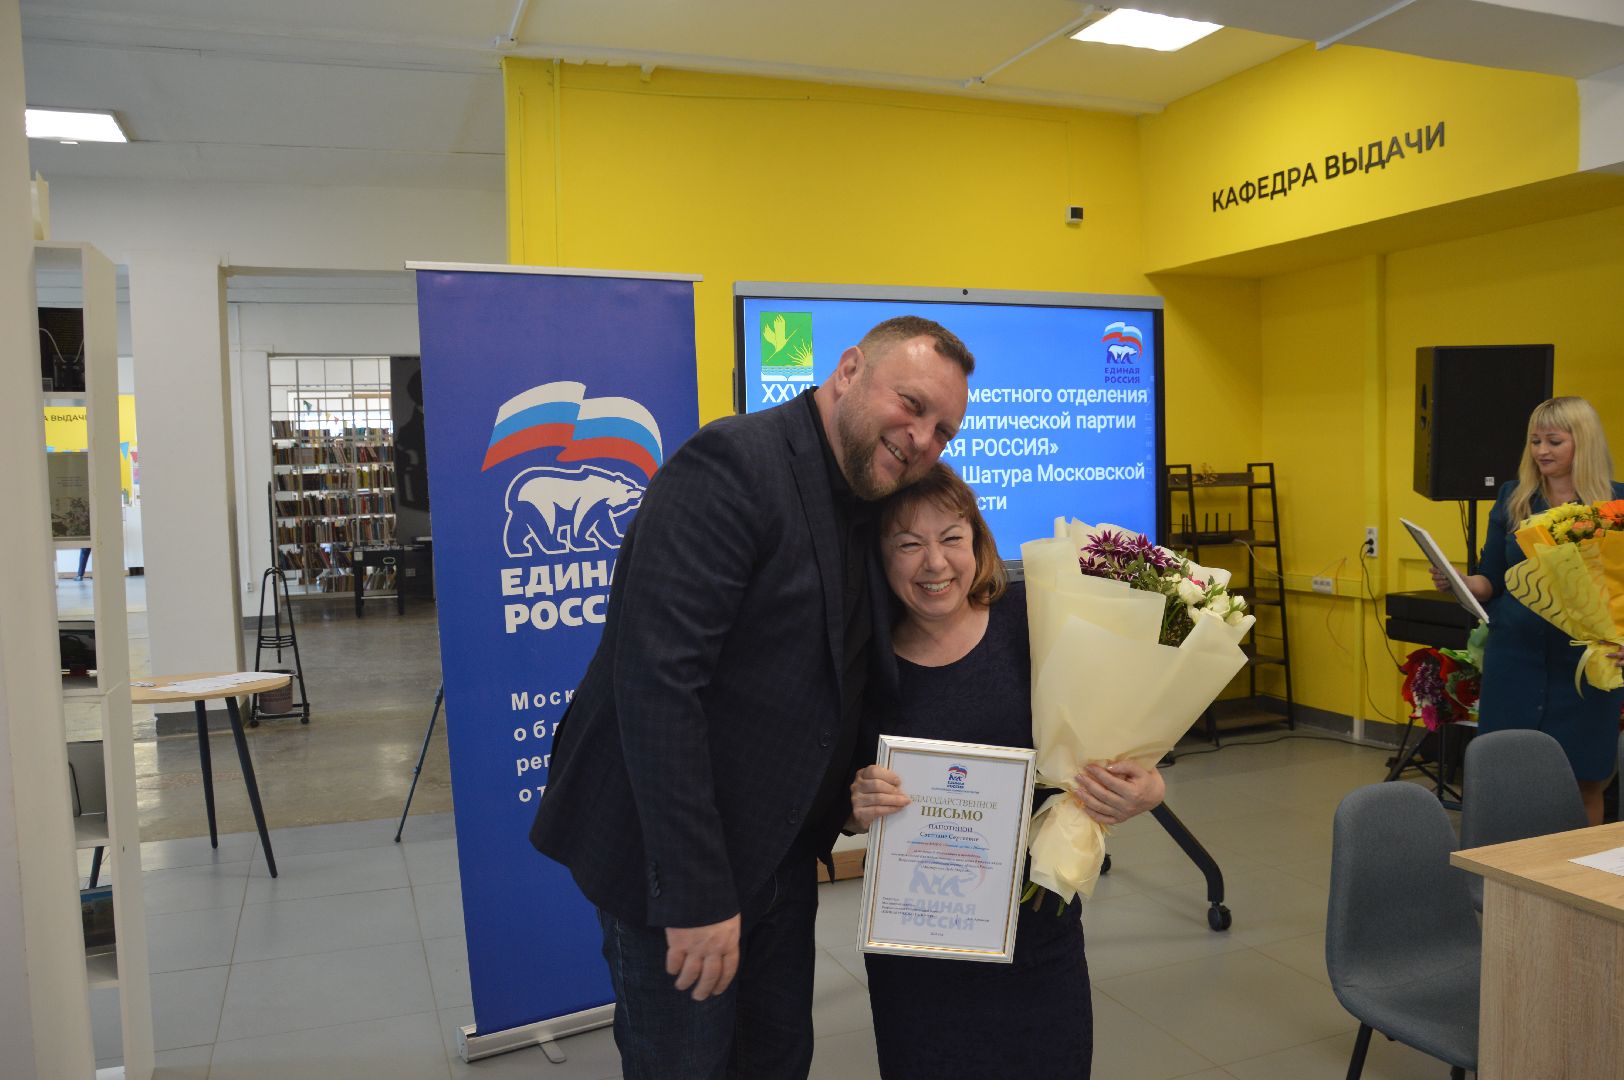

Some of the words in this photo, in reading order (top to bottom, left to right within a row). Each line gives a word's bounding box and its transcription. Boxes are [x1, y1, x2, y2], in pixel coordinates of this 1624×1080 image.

[1212, 162, 1318, 213] КАФЕДРА
[1325, 121, 1446, 180] ВЫДАЧИ
[1104, 367, 1140, 375] ЕДИНАЯ
[1104, 376, 1140, 384] РОССИЯ
[761, 383, 817, 403] XXV
[967, 388, 1053, 403] местного
[1057, 388, 1148, 406] отделения
[960, 411, 1071, 430] литической
[1076, 415, 1136, 433] партии
[972, 437, 1059, 457] РОССИЯ»
[962, 465, 1033, 488] Шатура
[1037, 462, 1145, 482] Московской
[501, 558, 617, 598] ЕДИН
[504, 595, 610, 634] РОСС
[920, 805, 983, 822] ПИСЬМО
